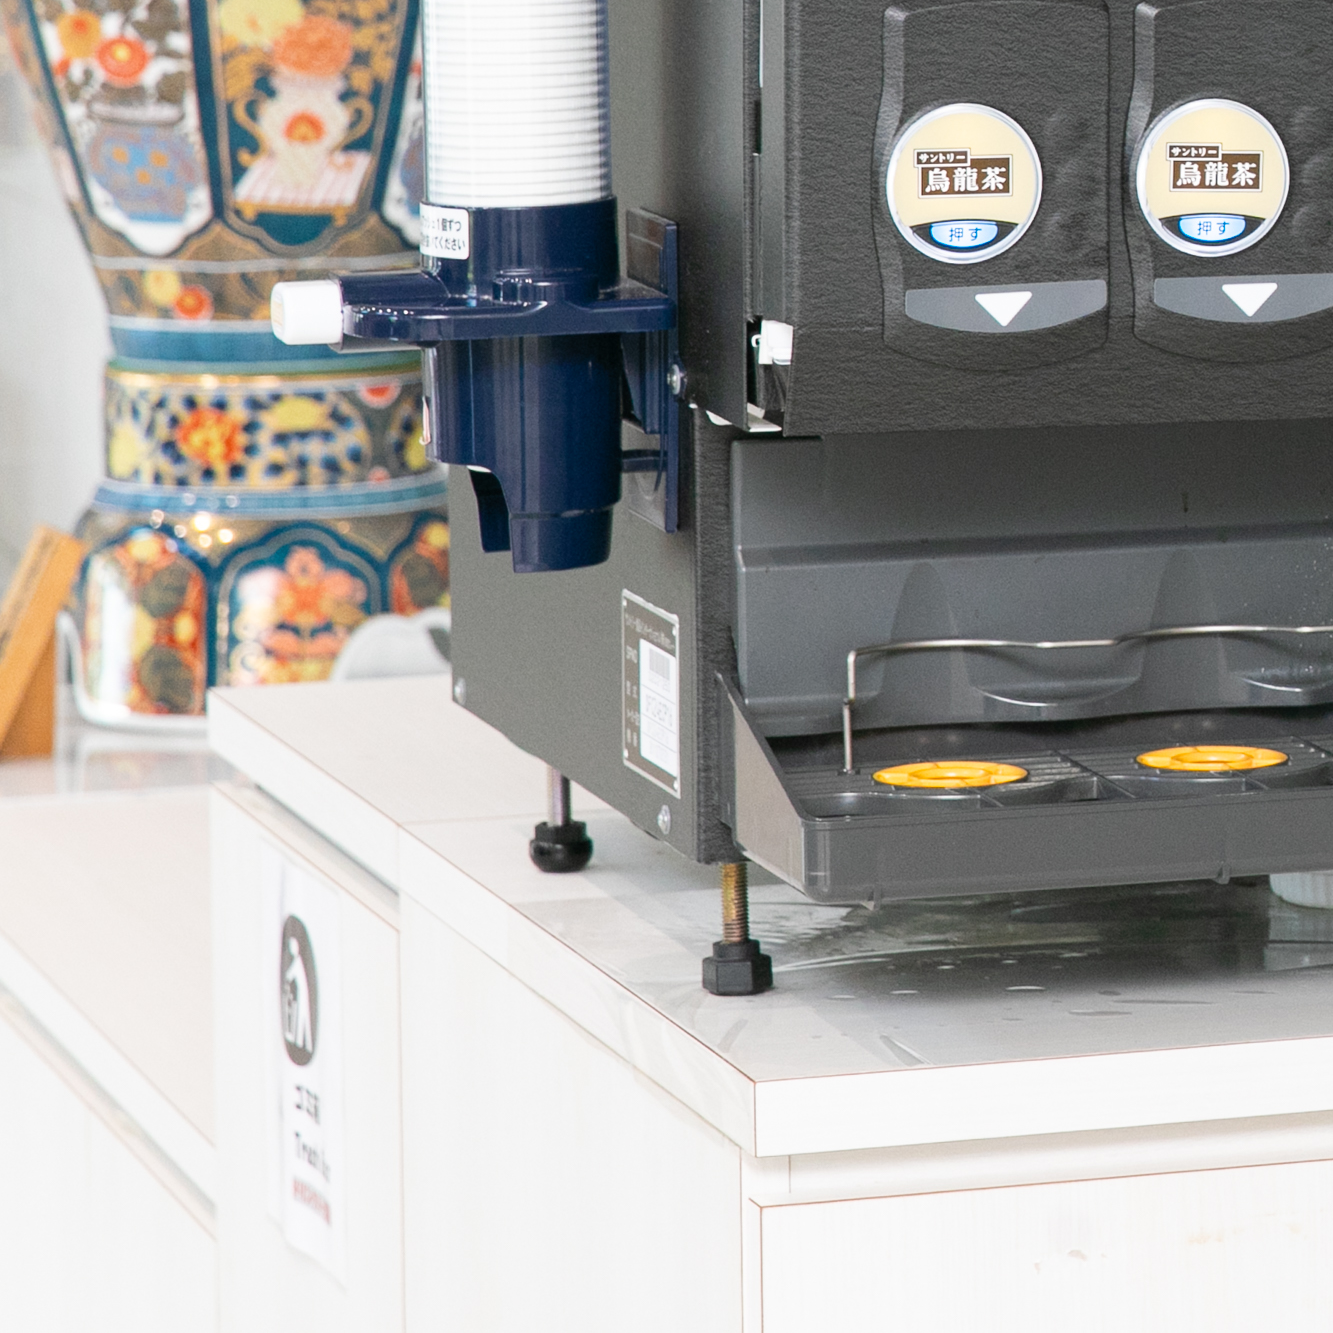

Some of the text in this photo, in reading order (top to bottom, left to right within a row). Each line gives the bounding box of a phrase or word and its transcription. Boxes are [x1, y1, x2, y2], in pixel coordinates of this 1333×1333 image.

[918, 152, 967, 164] サントリー
[1170, 146, 1217, 157] サントリー
[925, 166, 1007, 193] 烏龍茶
[1176, 161, 1257, 187] 烏龍茶
[948, 227, 983, 243] 押す
[1196, 221, 1230, 236] 押す
